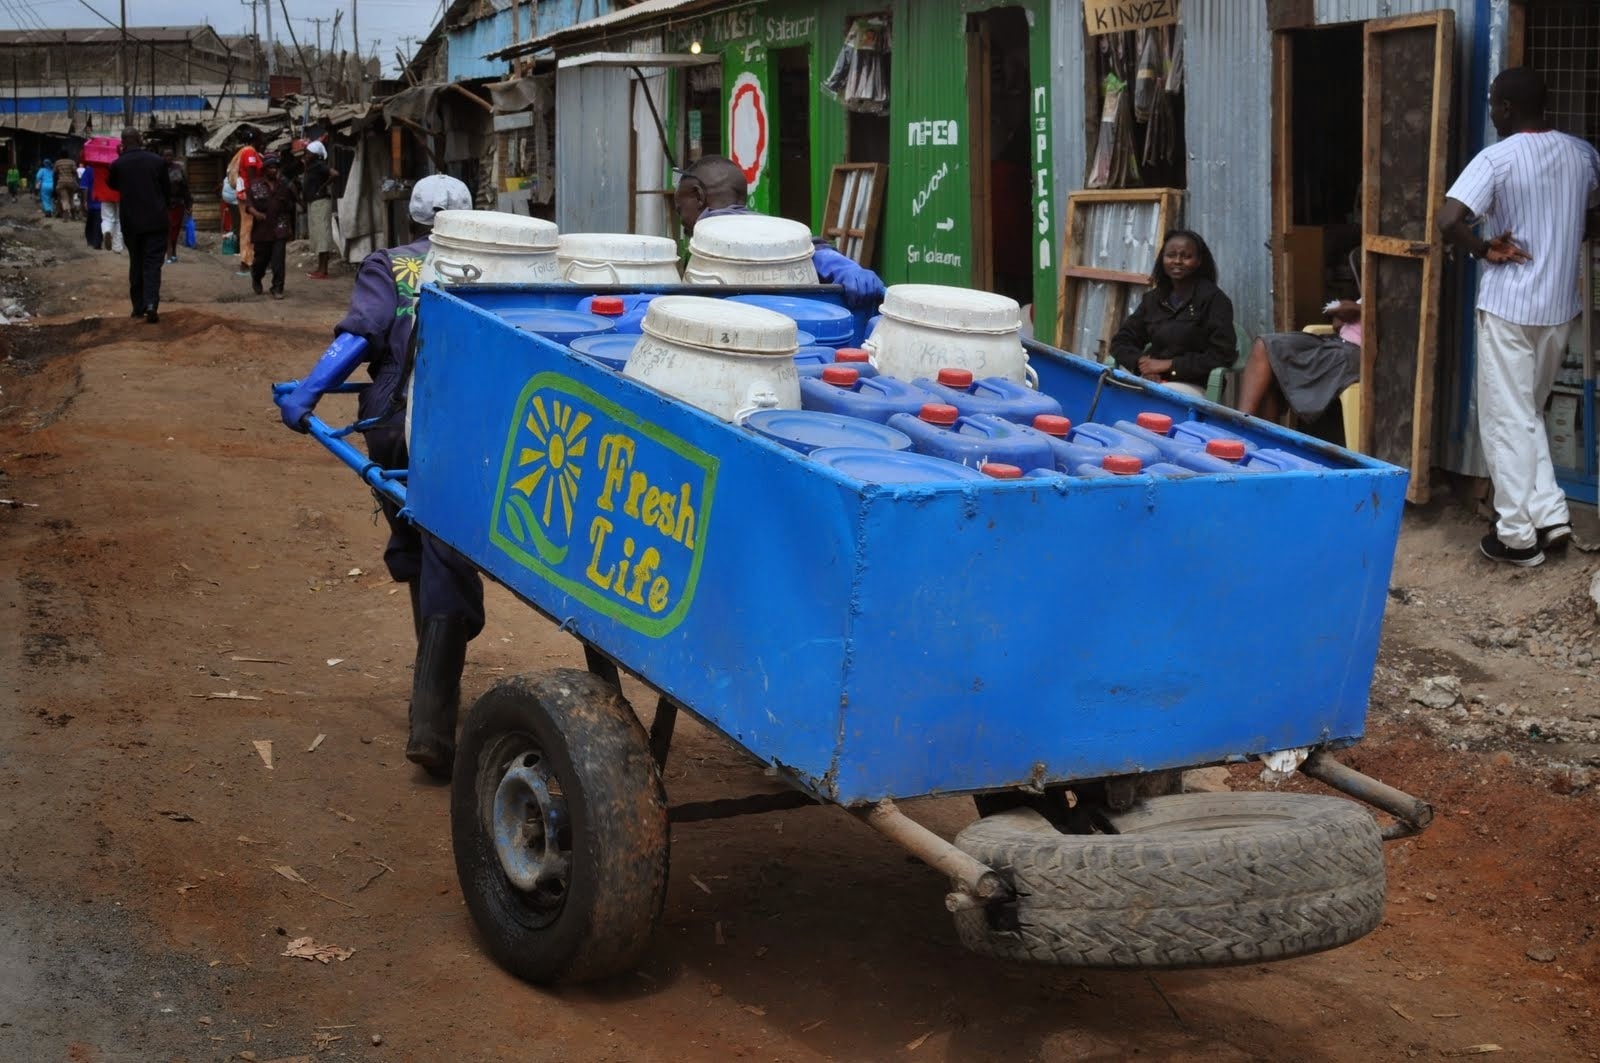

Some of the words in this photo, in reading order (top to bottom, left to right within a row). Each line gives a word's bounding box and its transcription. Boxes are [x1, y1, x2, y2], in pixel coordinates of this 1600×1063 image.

[1094, 0, 1176, 30] KINYOZI
[597, 432, 696, 550] Fresh
[586, 515, 671, 613] Life
